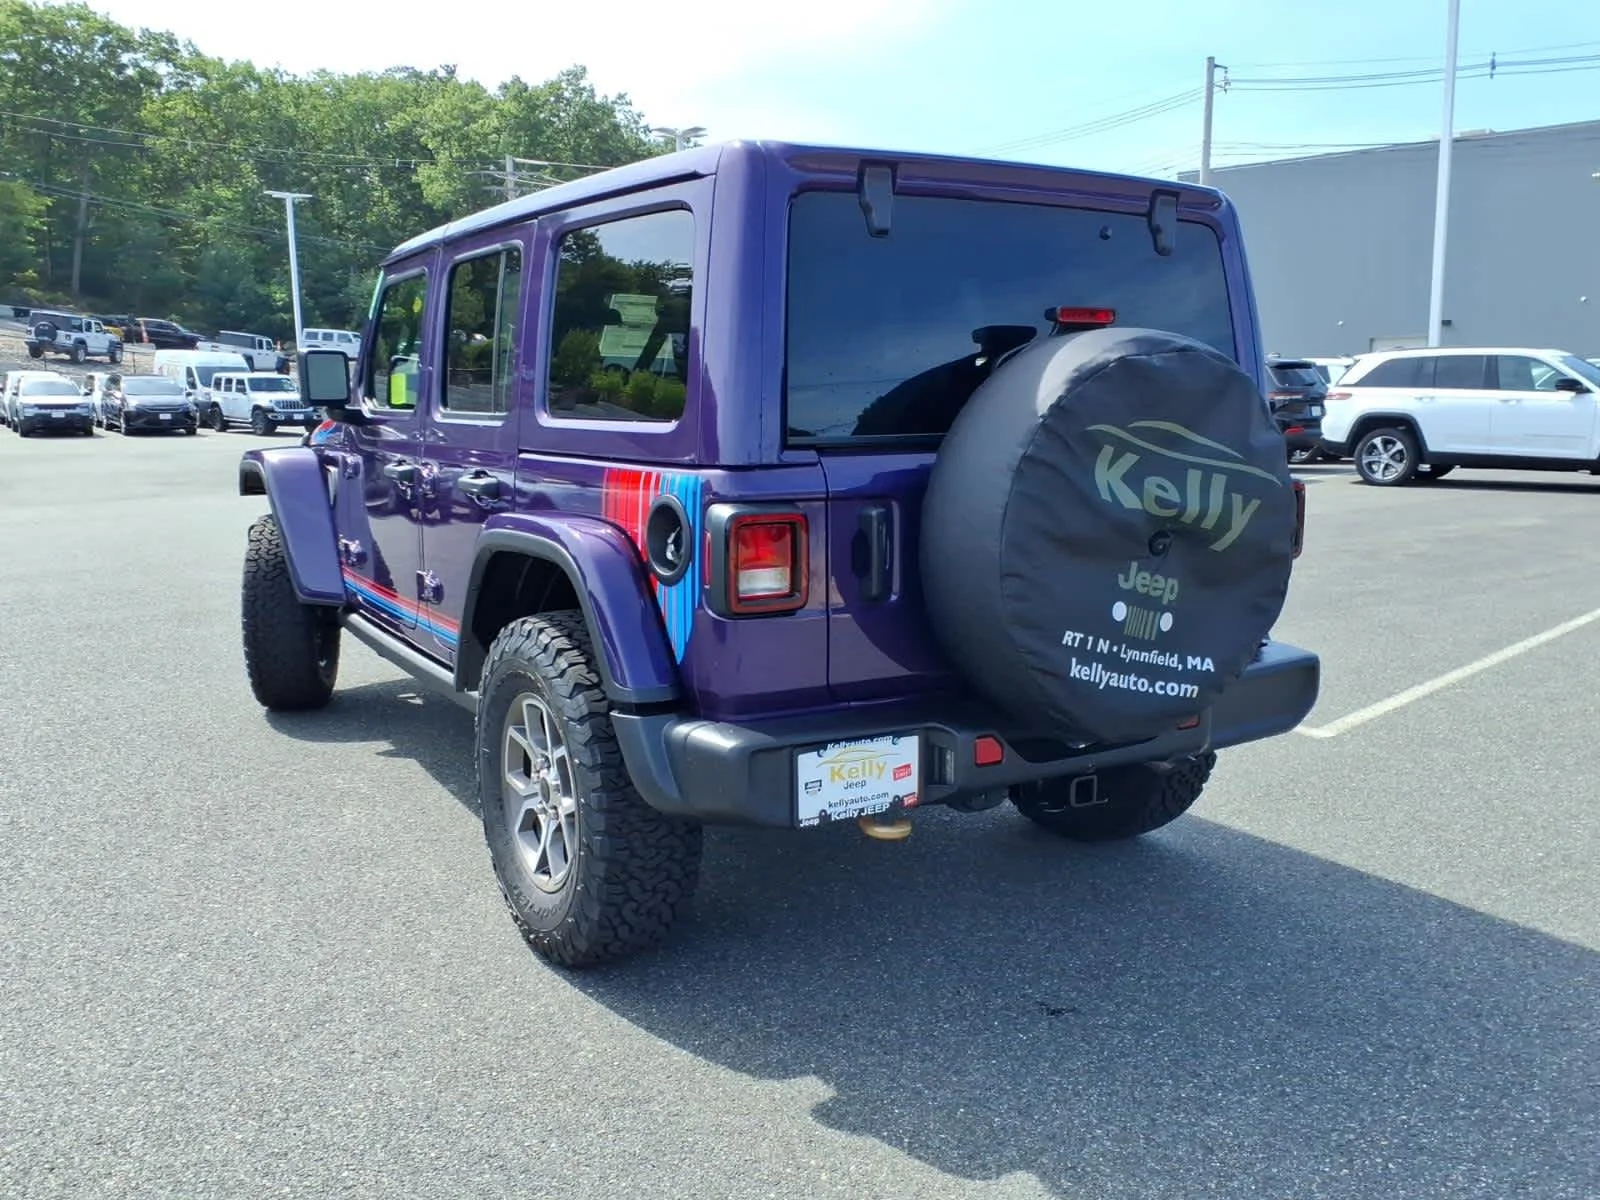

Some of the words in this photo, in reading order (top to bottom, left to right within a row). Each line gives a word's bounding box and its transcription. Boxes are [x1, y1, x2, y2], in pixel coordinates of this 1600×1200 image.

[1094, 444, 1262, 552] Kelly
[1118, 561, 1179, 604] Jeep
[1062, 630, 1084, 648] RT
[1087, 635, 1094, 651] 1
[1097, 638, 1110, 654] N
[1120, 643, 1184, 671] Lynnfield,
[1187, 655, 1215, 672] MA
[1069, 657, 1200, 698] kellyauto.com
[829, 759, 887, 783] Kelly
[843, 779, 867, 790] Jeep
[828, 792, 889, 808] kellyauto.com
[831, 808, 860, 821] Kelly
[861, 803, 890, 816] JEEP
